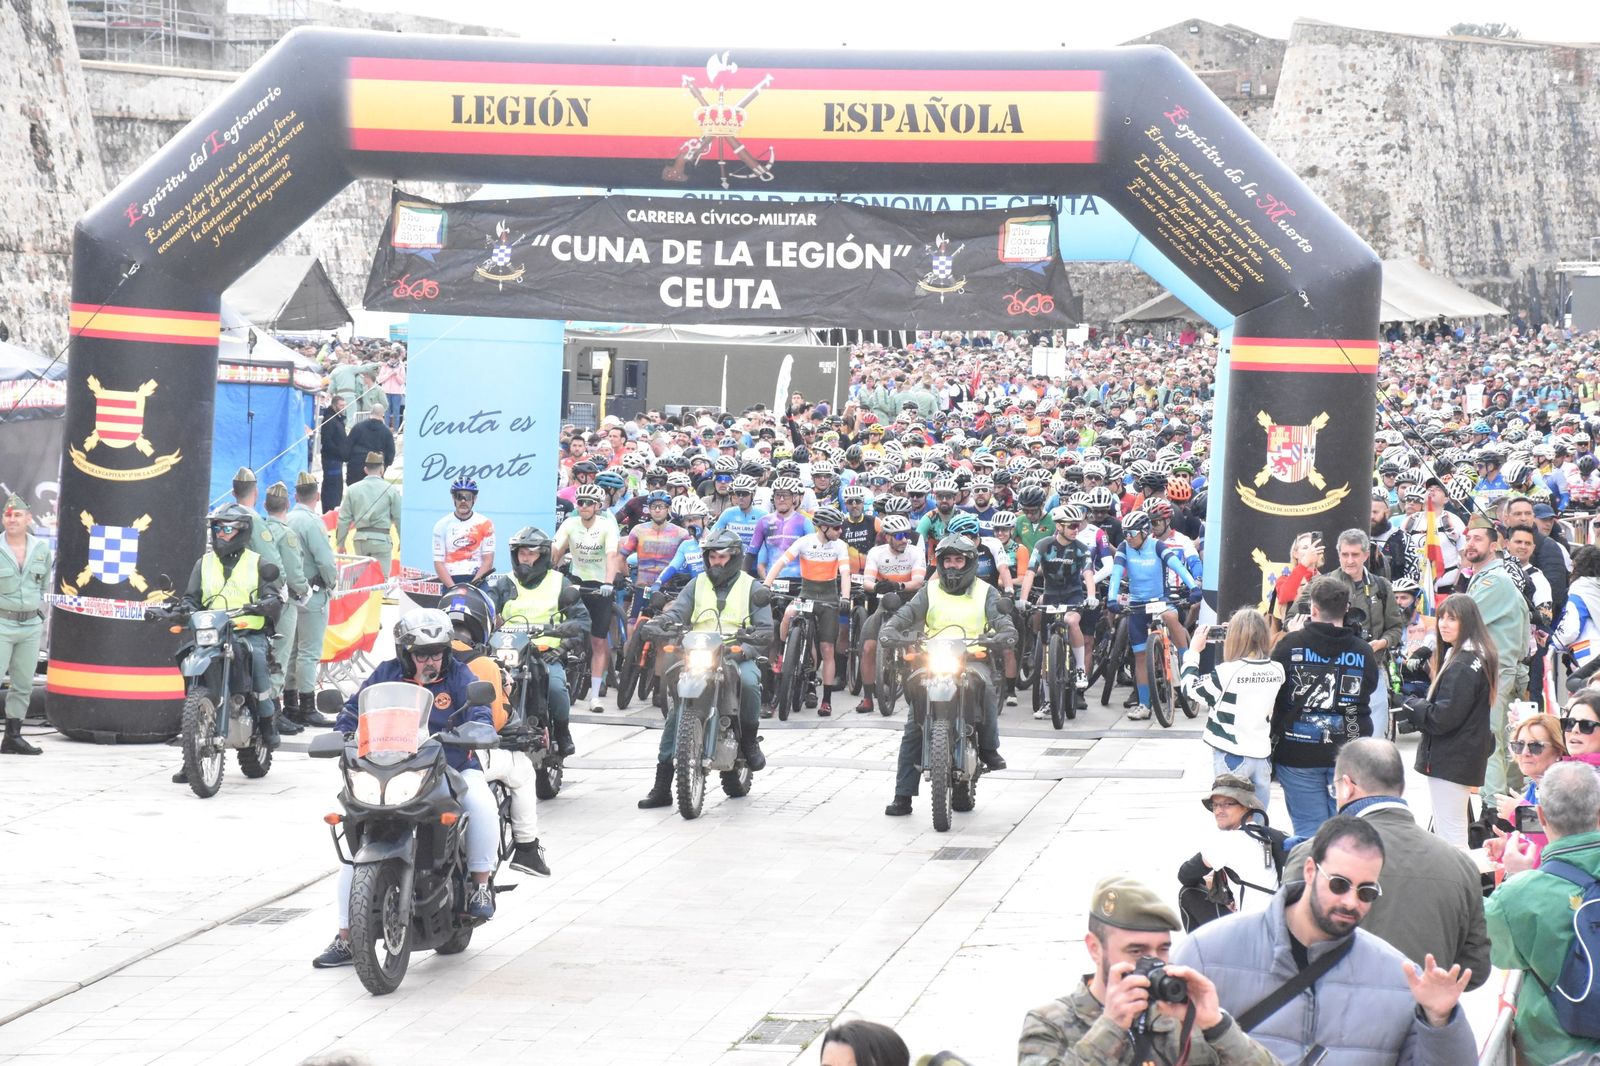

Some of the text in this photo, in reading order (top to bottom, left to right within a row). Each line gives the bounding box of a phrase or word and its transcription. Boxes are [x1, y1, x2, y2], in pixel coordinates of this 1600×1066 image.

[451, 90, 591, 127] LEGIÓN
[823, 96, 1024, 134] ESPAÑOLA
[124, 87, 281, 227] Espíritu del Legionario
[210, 195, 220, 208] de
[220, 174, 246, 199] buscar
[247, 147, 277, 176] siempre
[278, 121, 305, 148] acortar
[145, 225, 162, 244] Es
[185, 204, 192, 215] y
[192, 192, 205, 205] sin
[237, 152, 247, 165] de
[268, 131, 275, 143] y
[1157, 141, 1180, 163] morir
[1179, 161, 1189, 173] en
[1197, 179, 1228, 210] combate
[1243, 225, 1269, 249] mayor
[1163, 104, 1313, 253] Espíritu de la Muerte
[192, 232, 201, 243] la
[202, 202, 237, 235] distancia
[238, 189, 251, 203] con
[260, 154, 290, 183] enemigo
[213, 237, 220, 247] y
[219, 216, 241, 235] llegar
[256, 171, 292, 204] bayoneta
[627, 208, 817, 226] CARRERA CÍVICO-MILITAR
[1177, 179, 1201, 205] muere
[1215, 216, 1232, 233] que
[1231, 231, 1248, 249] una
[1007, 241, 1032, 250] Shop
[1009, 223, 1027, 232] The
[1149, 171, 1176, 197] muerte
[1241, 261, 1265, 284] morir
[1199, 235, 1218, 256] como
[662, 239, 702, 265] DE
[715, 240, 753, 266] LA
[660, 276, 782, 310] CEUTA
[419, 404, 537, 438] Ceuta es
[421, 453, 537, 482] Deporte
[1237, 676, 1265, 684] ESPIRITO
